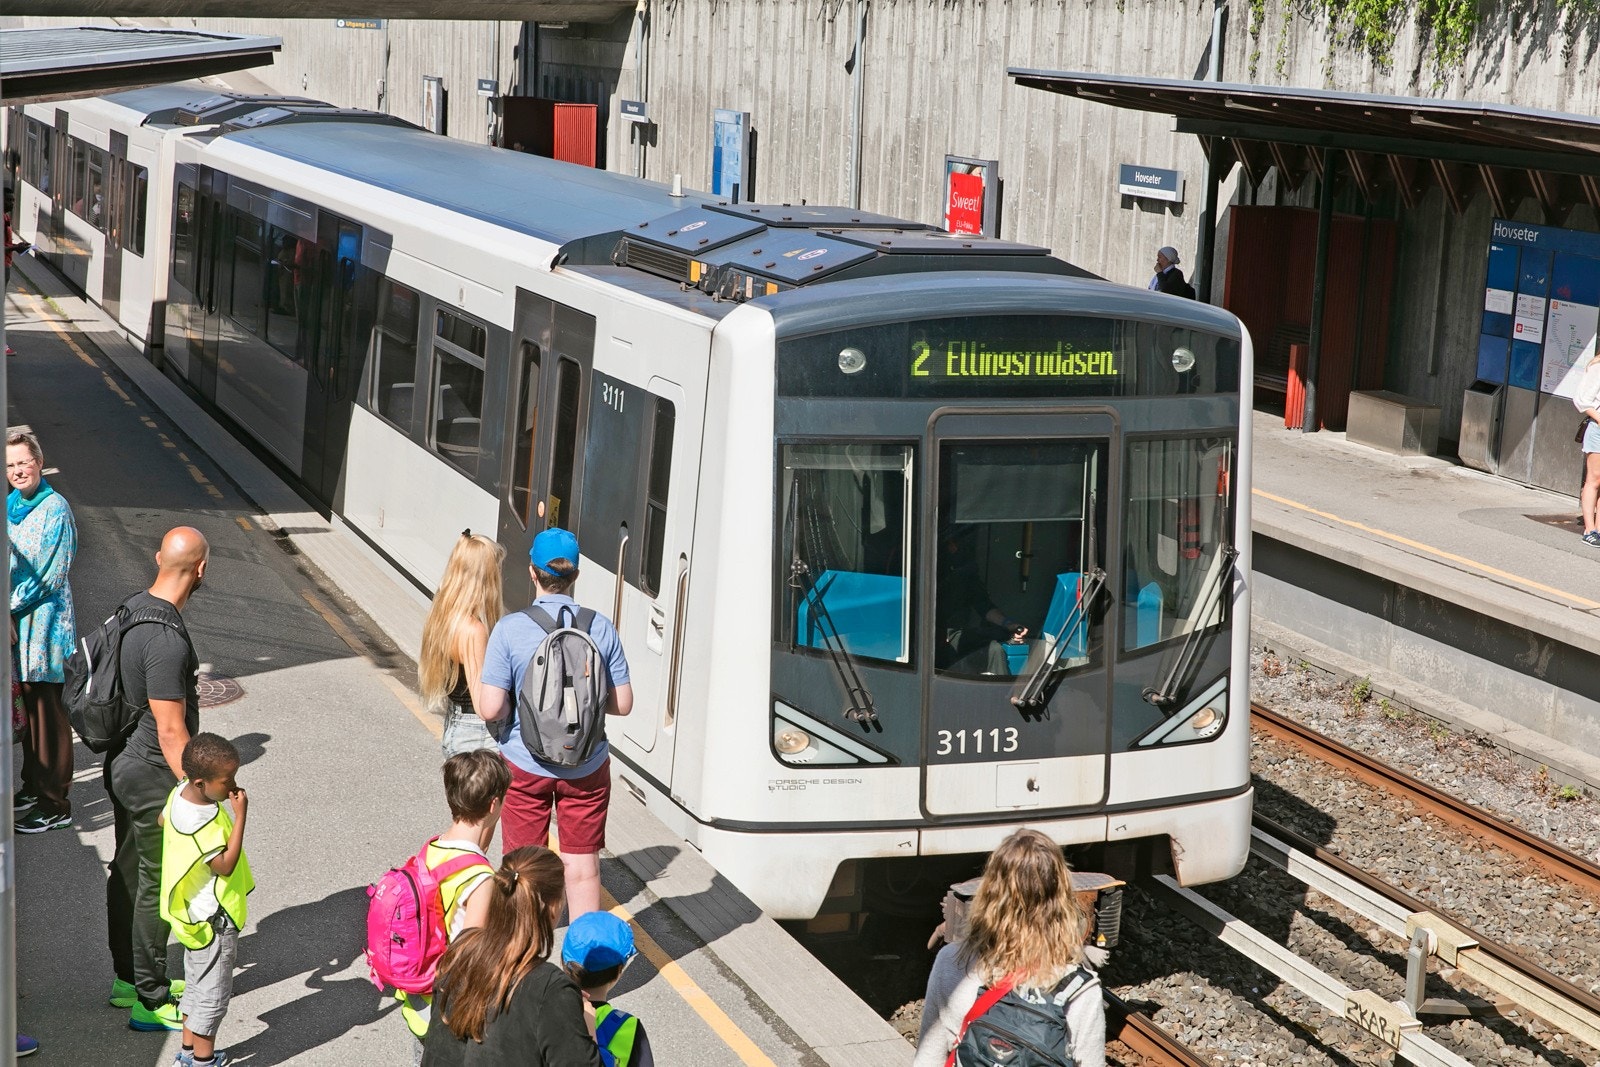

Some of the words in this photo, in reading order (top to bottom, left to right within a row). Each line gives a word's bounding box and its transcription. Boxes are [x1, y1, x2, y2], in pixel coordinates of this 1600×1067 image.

[1134, 171, 1161, 185] Hovseter
[951, 191, 979, 212] Sweet!
[1493, 222, 1539, 242] Hovseter
[911, 341, 930, 376] 2
[936, 727, 1019, 756] 31113
